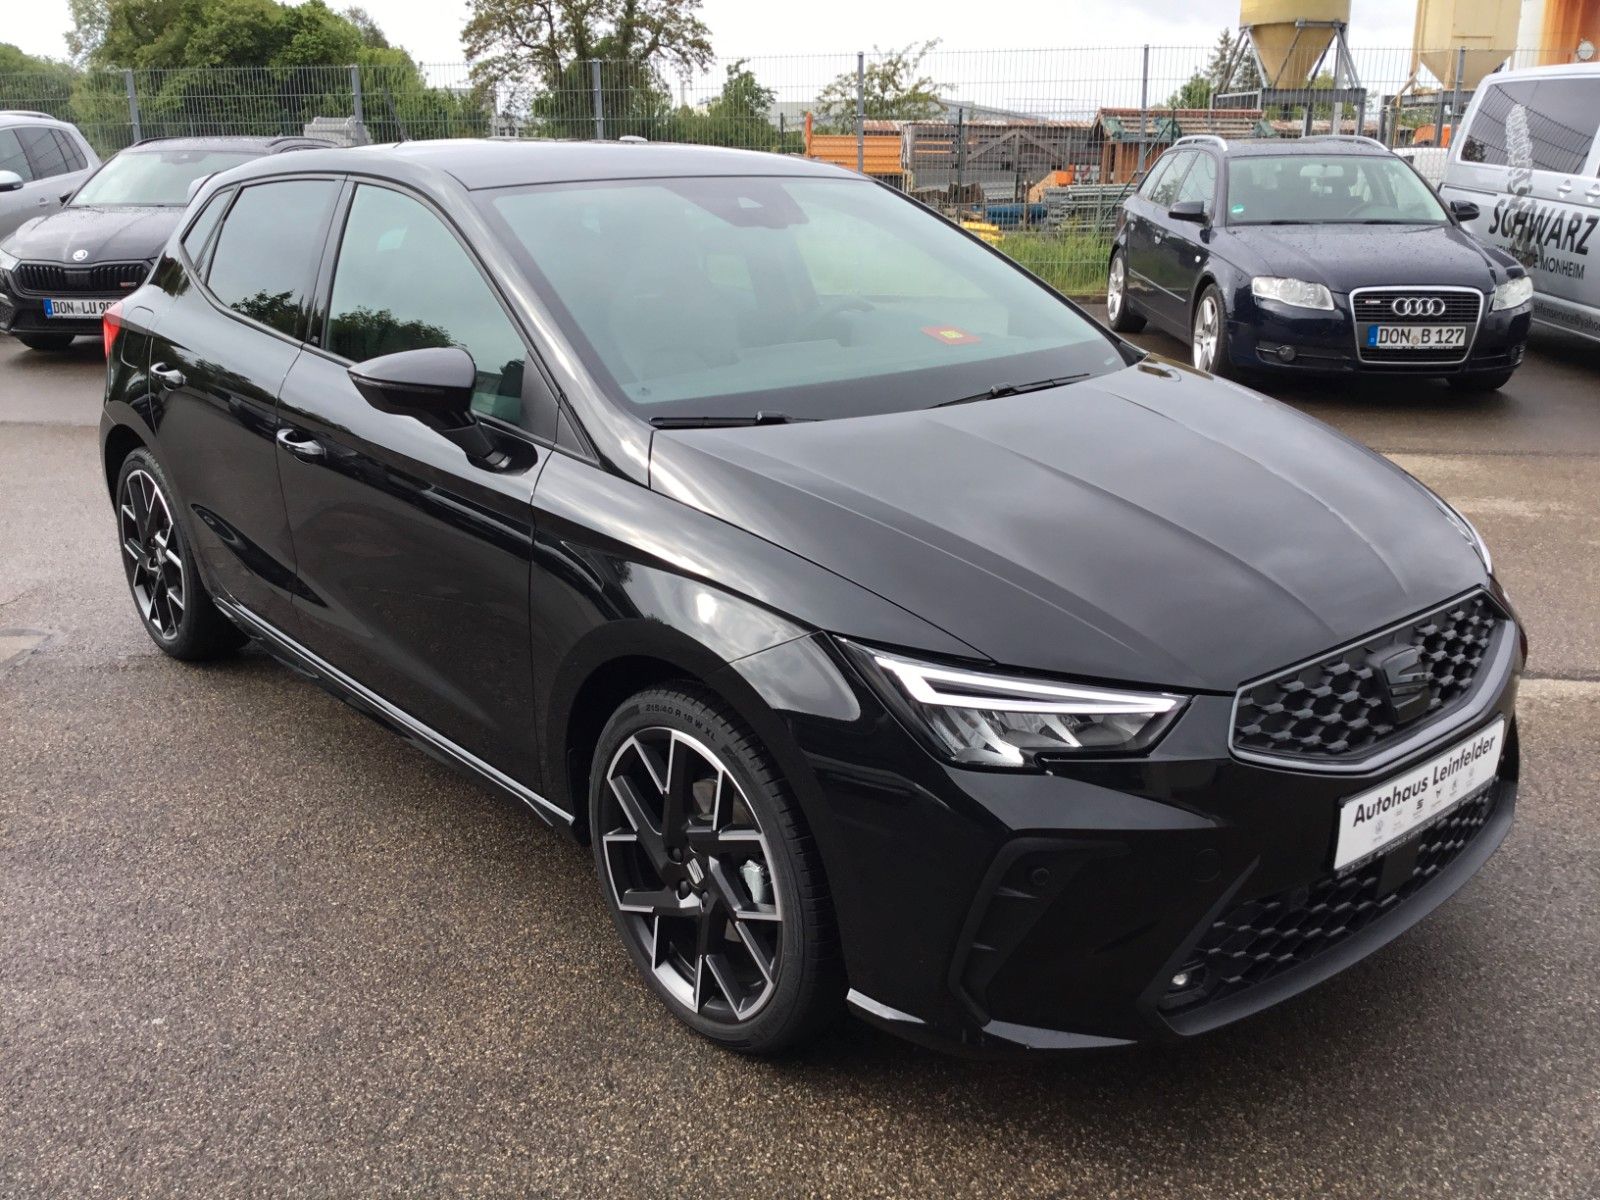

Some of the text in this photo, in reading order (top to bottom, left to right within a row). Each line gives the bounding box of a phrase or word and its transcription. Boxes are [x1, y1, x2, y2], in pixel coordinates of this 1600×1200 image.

[1488, 199, 1600, 255] SCHWARZ
[1540, 255, 1585, 280] MONHEIM
[53, 301, 74, 314] DON
[81, 302, 97, 314] LU
[1379, 328, 1464, 344] DON B 127
[646, 704, 674, 714] 215/40
[675, 709, 682, 717] R
[684, 713, 694, 724] 18
[1353, 777, 1428, 827] Autohaus
[1432, 736, 1495, 786] Leinfelder
